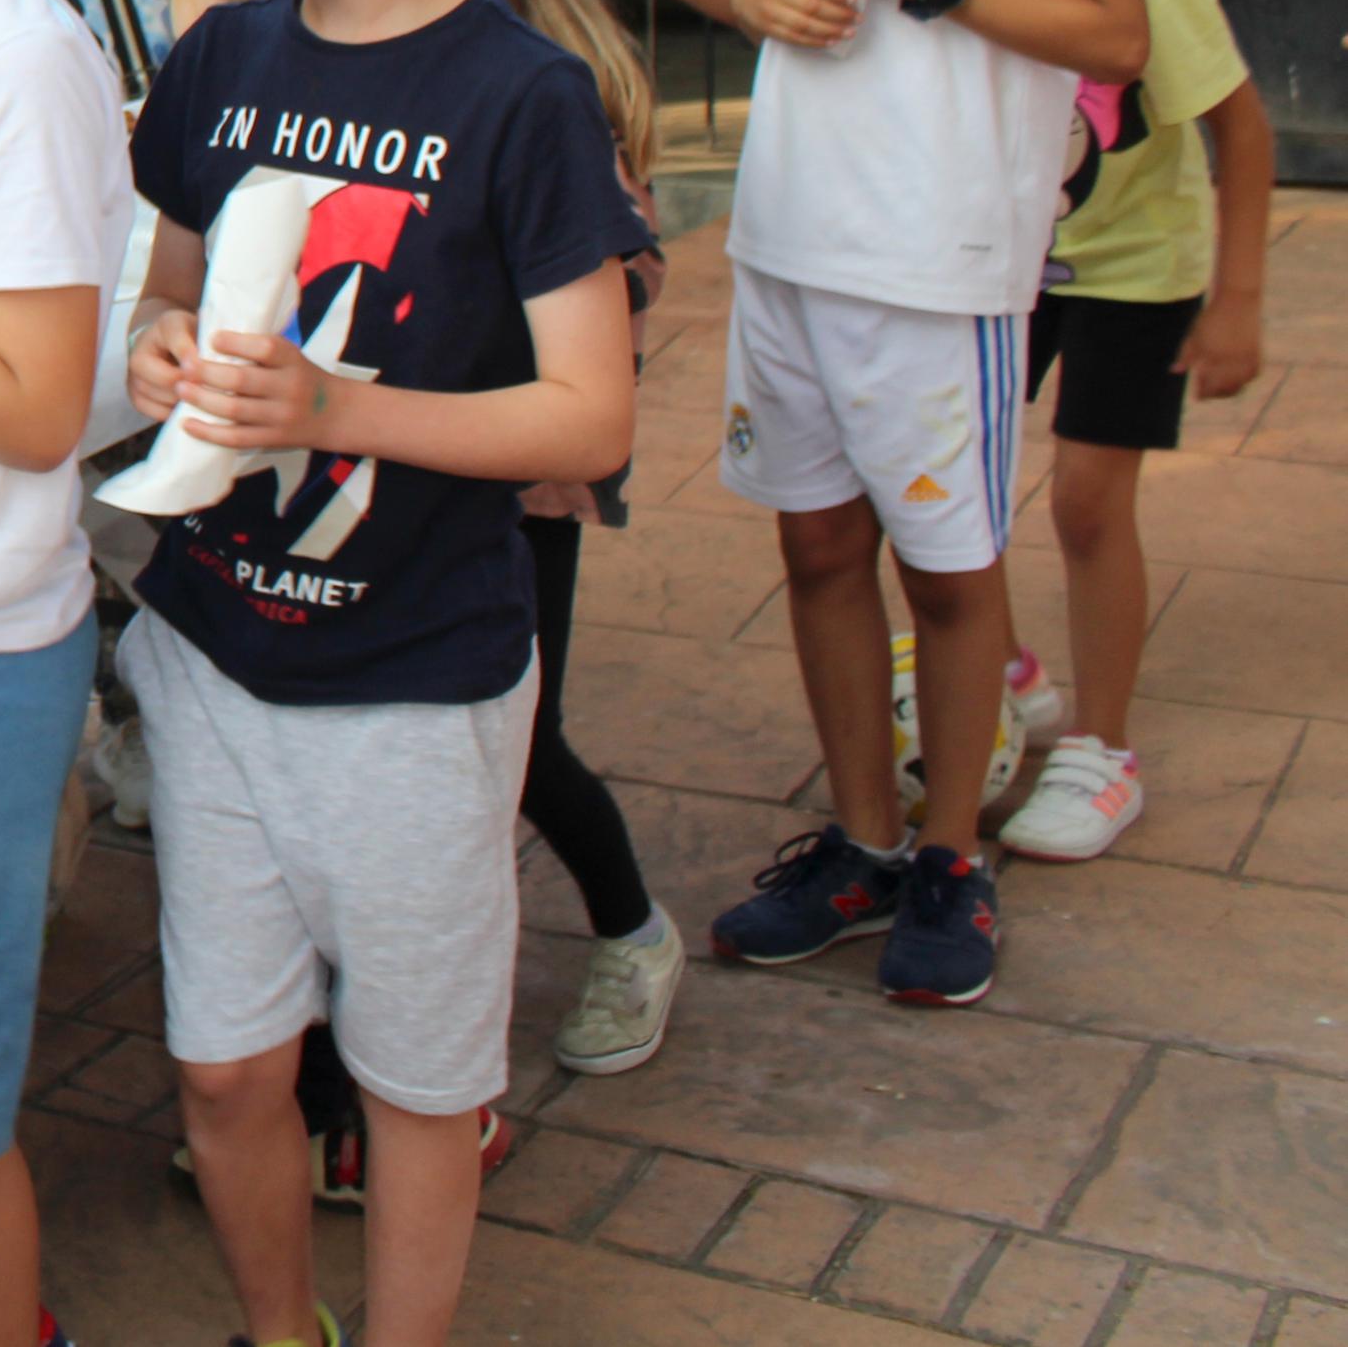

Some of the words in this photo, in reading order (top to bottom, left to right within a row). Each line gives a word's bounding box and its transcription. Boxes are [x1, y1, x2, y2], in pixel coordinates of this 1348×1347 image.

[208, 107, 256, 150] IN
[272, 112, 448, 181] HONOR
[235, 559, 369, 607] PLANET
